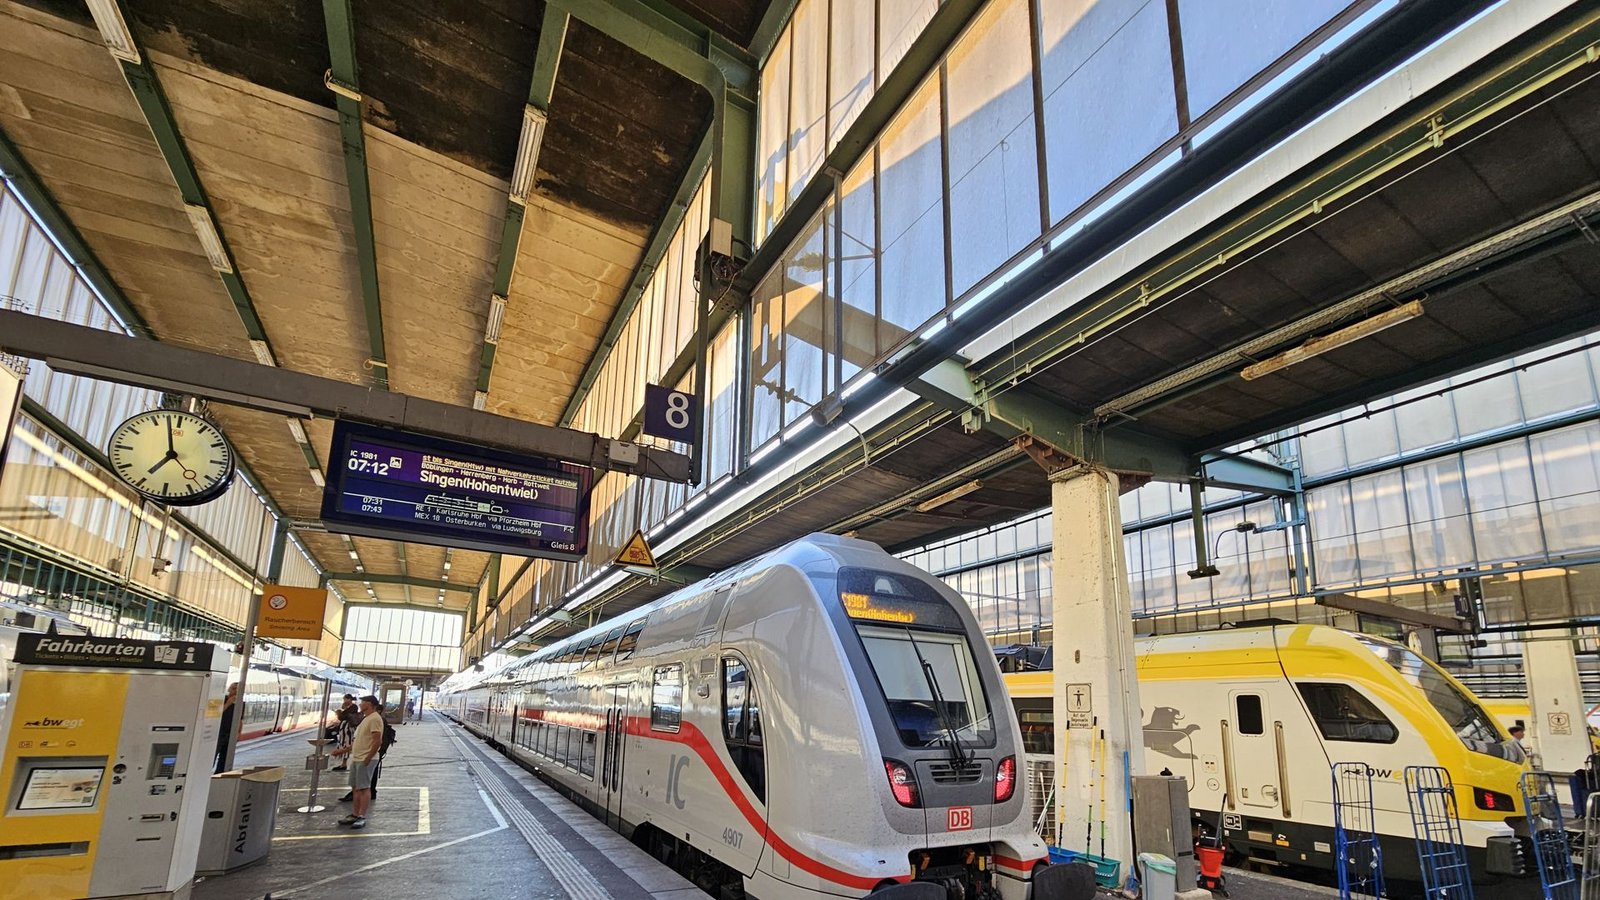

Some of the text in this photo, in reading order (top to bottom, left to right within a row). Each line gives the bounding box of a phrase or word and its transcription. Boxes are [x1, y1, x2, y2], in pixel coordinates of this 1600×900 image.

[665, 392, 690, 429] 8
[360, 451, 378, 461] 1981
[347, 458, 389, 476] 07:12
[460, 469, 497, 481] Herrenberg
[502, 475, 518, 484] Horb
[419, 470, 539, 500] Singen(Hohentwiel)
[361, 504, 383, 514] 07:43
[362, 496, 383, 506] 07:31
[414, 512, 430, 520] MEX
[445, 516, 487, 528] Osterburken
[491, 523, 502, 531] via
[502, 525, 542, 537] Ludwigsburg
[415, 504, 425, 512] RE
[436, 507, 470, 519] Karlsruhe
[470, 512, 483, 521] Hbf
[487, 515, 498, 523] via
[499, 515, 530, 528] Pforzheim
[550, 540, 575, 551] Gleis 8
[36, 638, 146, 656] Fahrkarten
[43, 717, 84, 730] bwegt
[665, 753, 690, 811] IC
[234, 803, 252, 854] Abfall
[950, 809, 971, 829] DB
[722, 826, 744, 850] 4907
